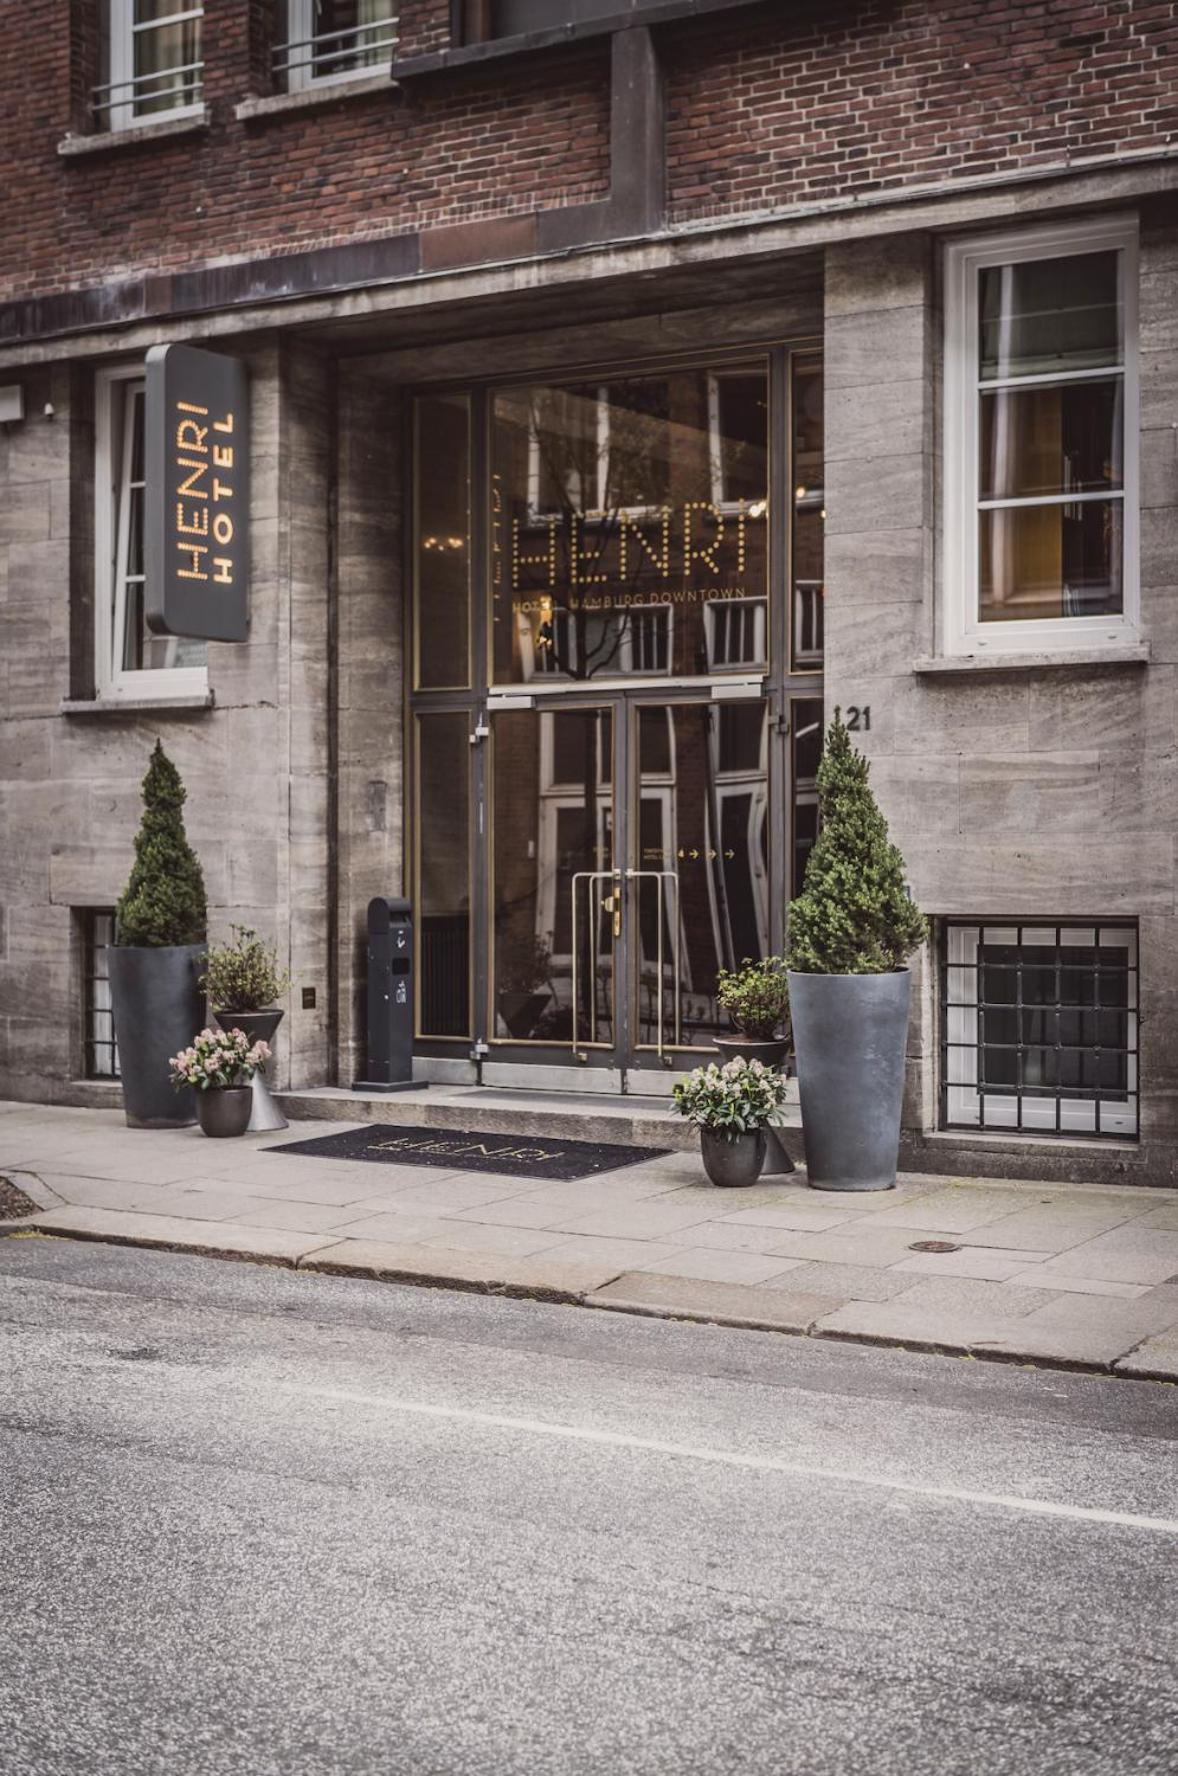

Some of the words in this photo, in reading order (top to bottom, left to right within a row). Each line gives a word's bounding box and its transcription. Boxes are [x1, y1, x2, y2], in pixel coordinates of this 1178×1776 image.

[177, 401, 208, 580] HENRI
[213, 413, 234, 584] HOTEL
[513, 498, 745, 588] HENRI
[512, 599, 558, 613] HOT
[650, 587, 745, 604] DOWNTOWN
[847, 706, 870, 731] 21
